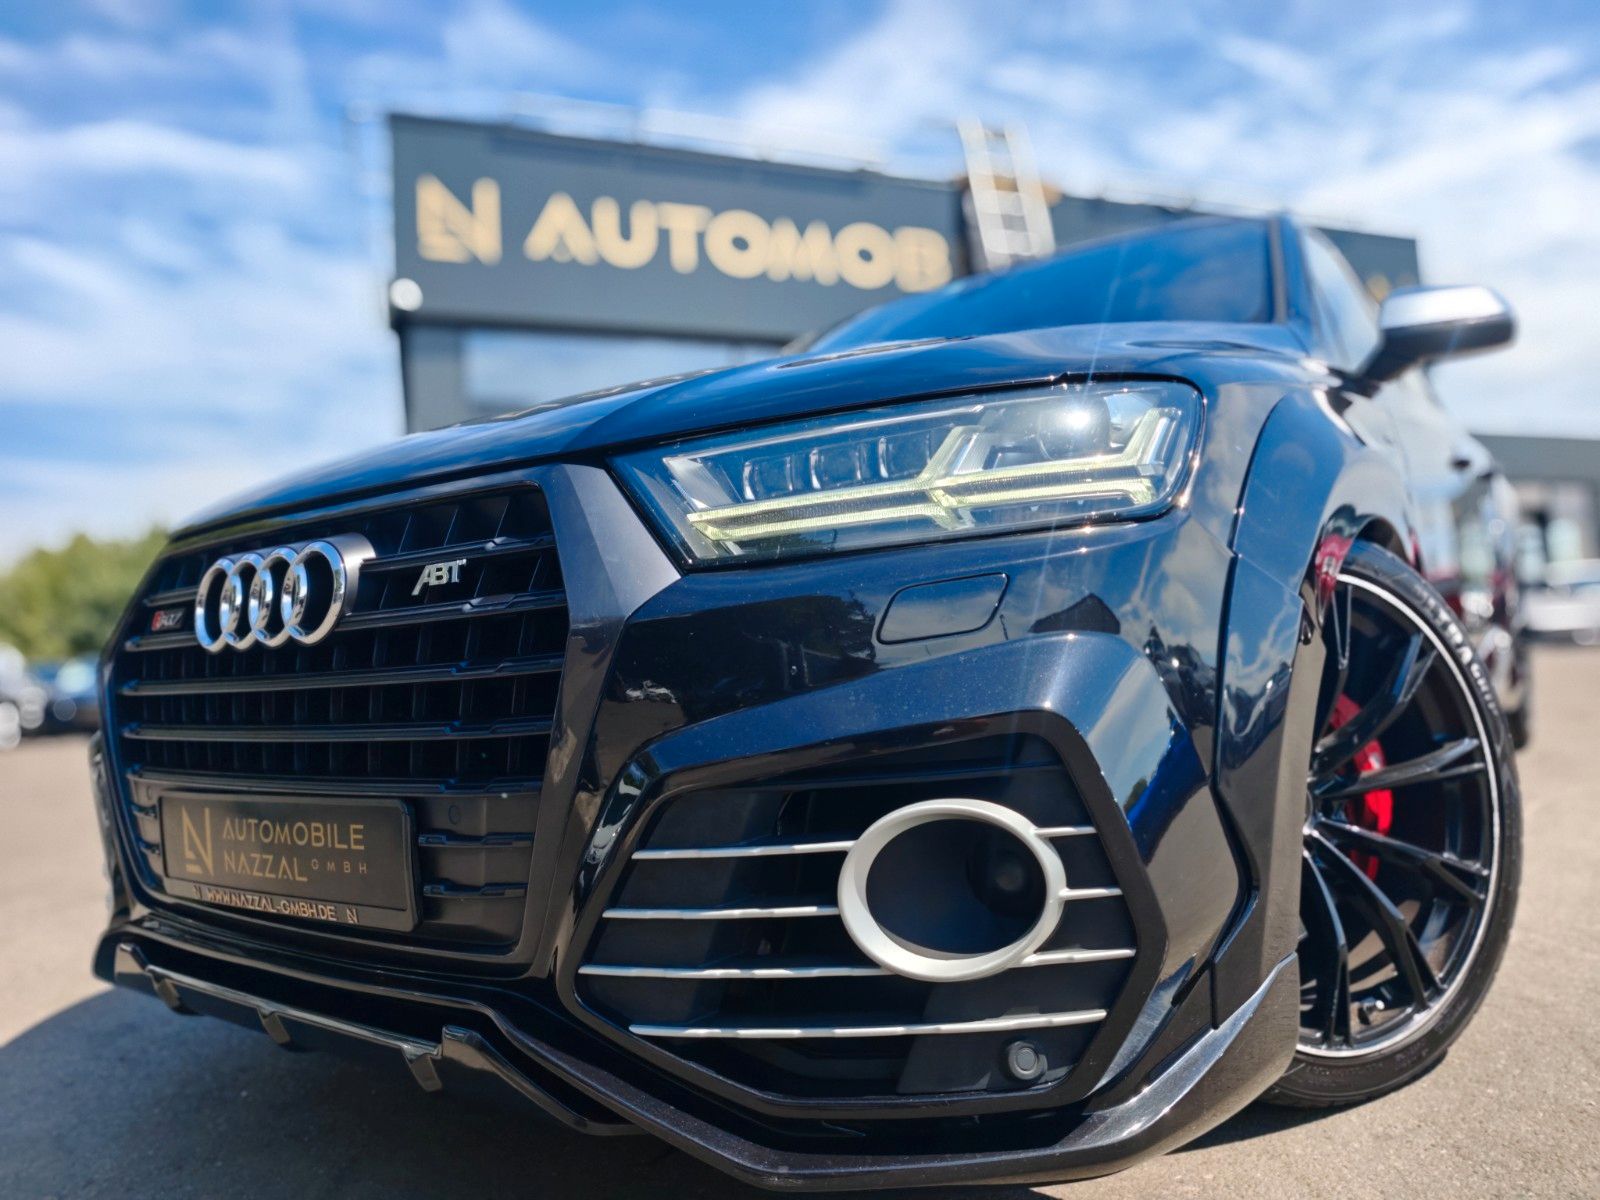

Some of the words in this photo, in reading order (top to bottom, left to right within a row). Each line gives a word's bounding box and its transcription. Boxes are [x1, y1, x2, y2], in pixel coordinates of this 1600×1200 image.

[411, 558, 467, 596] ABT
[222, 817, 365, 850] AUTOMOBILE
[224, 852, 308, 882] NAZZAL
